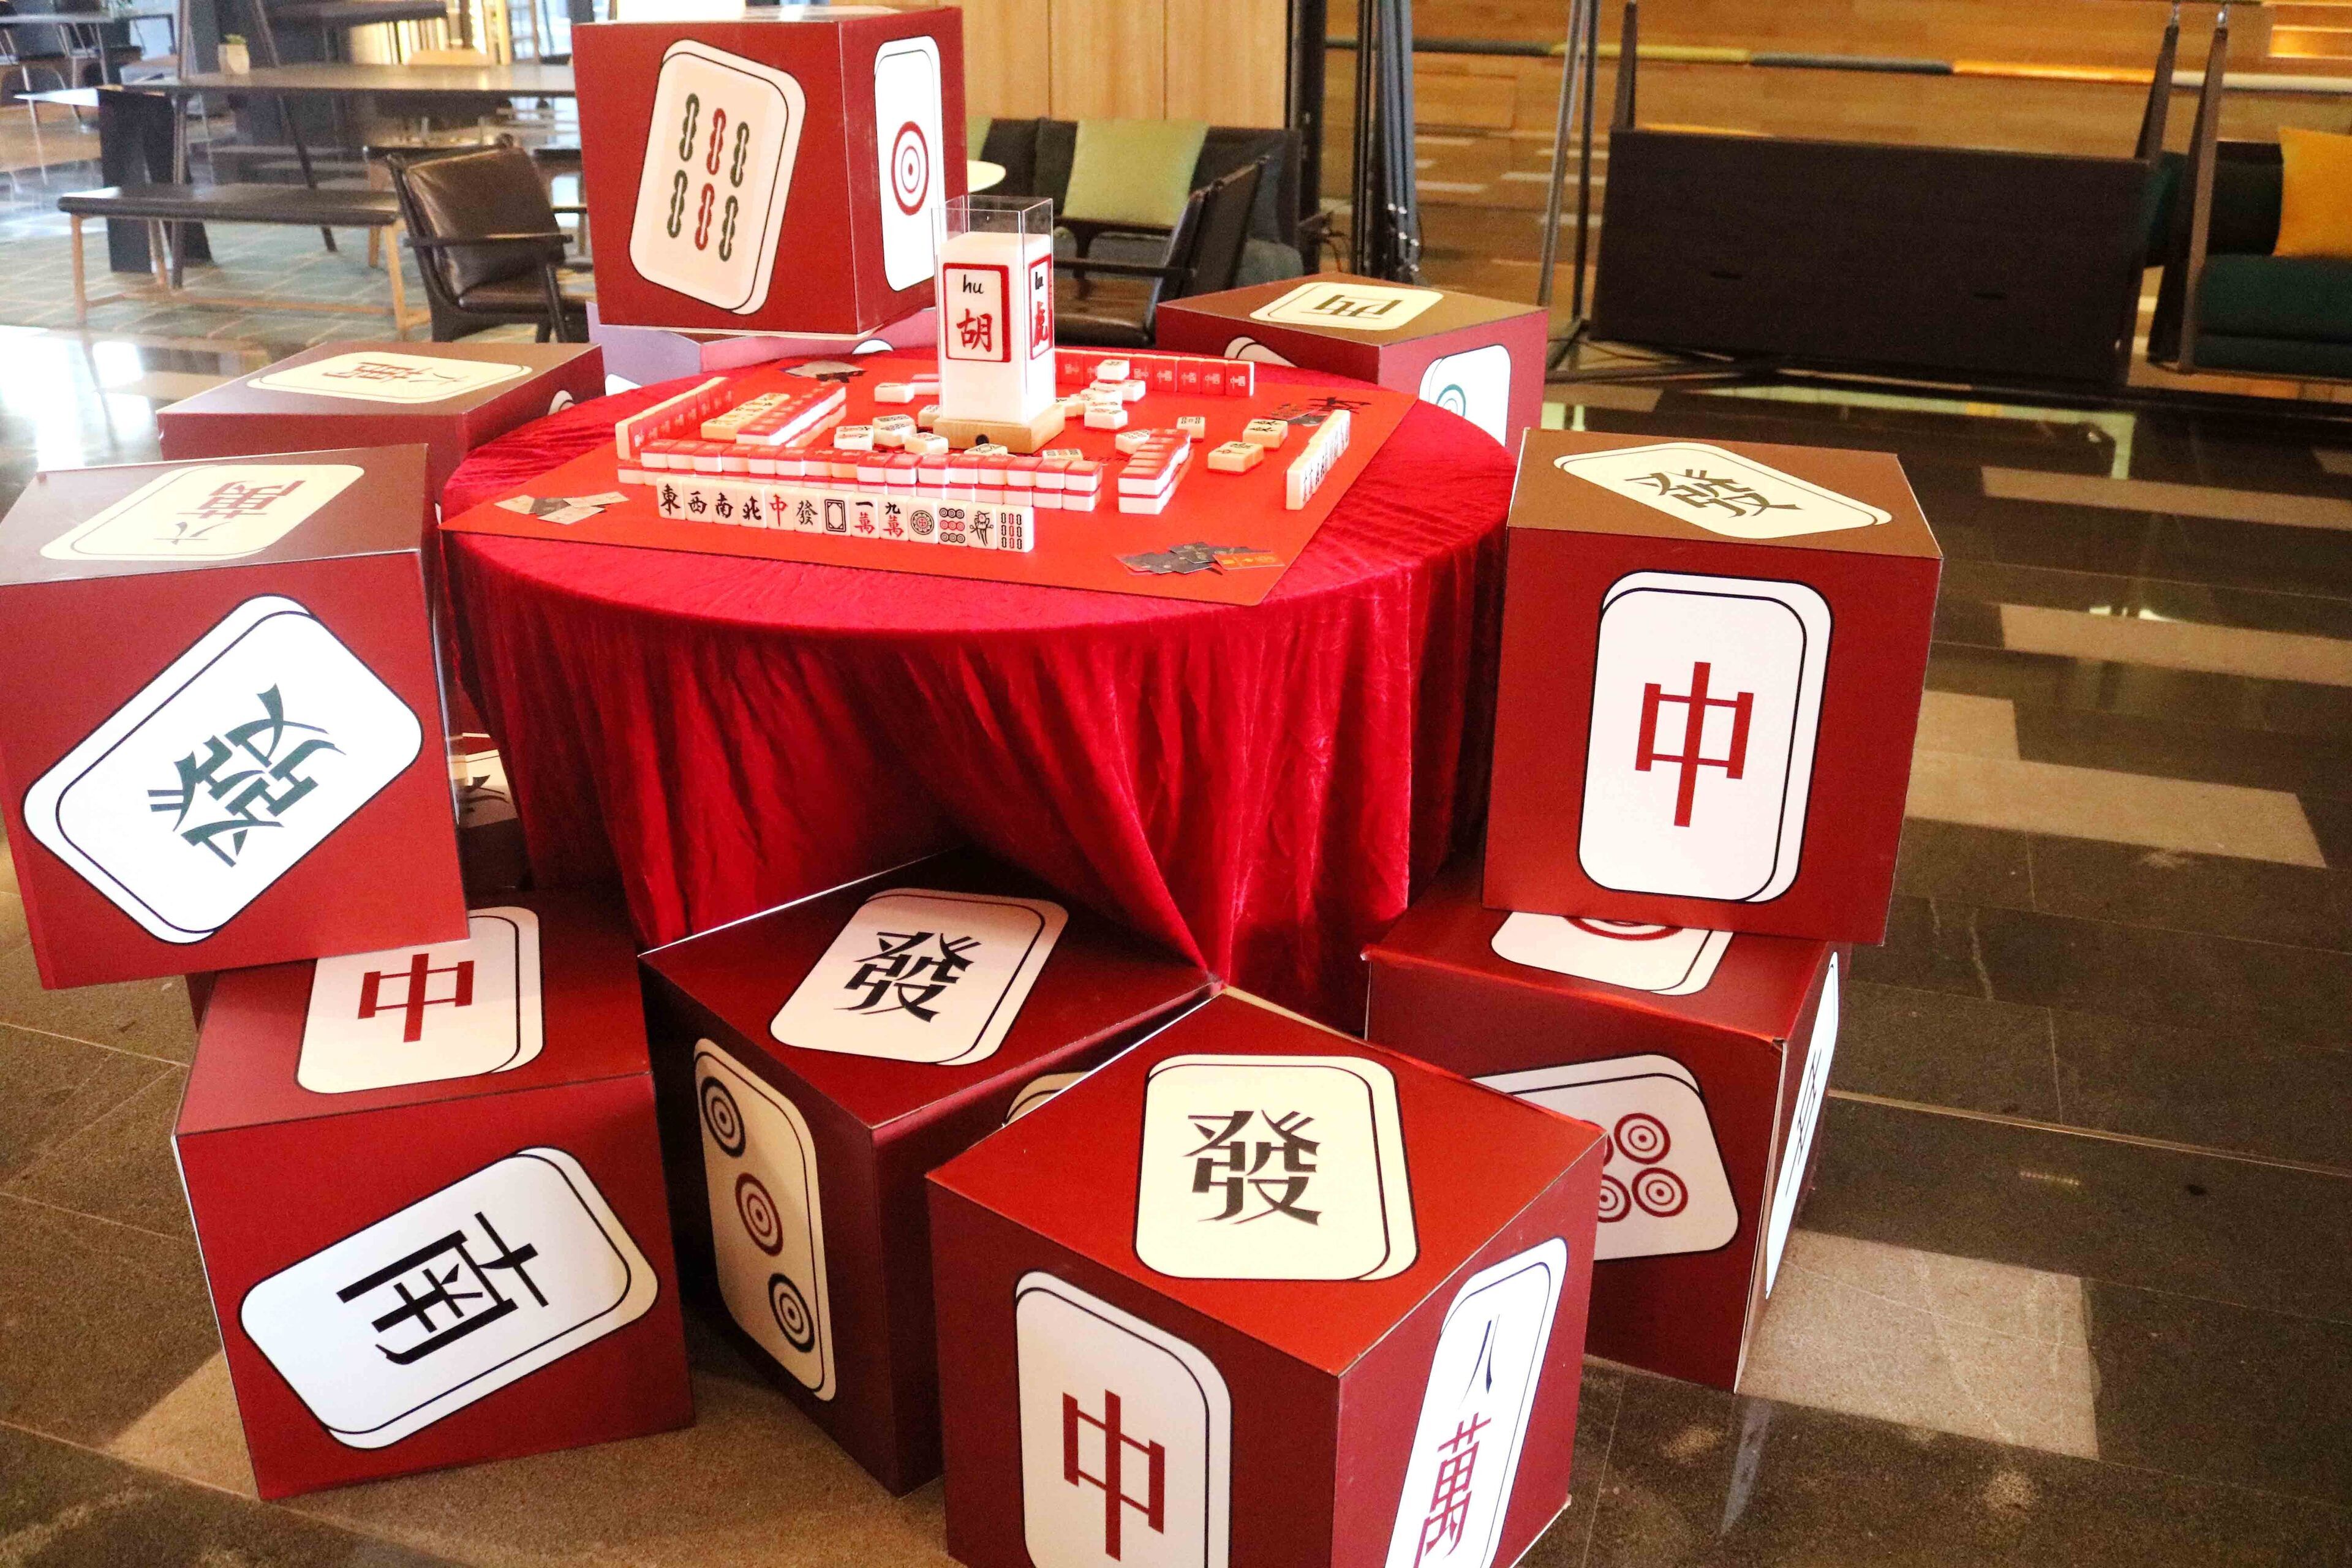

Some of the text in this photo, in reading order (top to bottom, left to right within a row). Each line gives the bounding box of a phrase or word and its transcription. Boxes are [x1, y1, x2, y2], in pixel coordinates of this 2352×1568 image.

[963, 274, 984, 294] hu
[1033, 301, 1048, 347] 虎
[1300, 294, 1403, 319] 西
[957, 309, 992, 352] 胡
[1624, 468, 1806, 519] 發
[147, 682, 346, 868] 發
[1635, 662, 1754, 827] 中
[357, 953, 475, 1042] 中
[834, 931, 981, 1022] 發
[1182, 1109, 1322, 1226] 發
[336, 1212, 548, 1365] 南
[1063, 1389, 1165, 1562] 中
